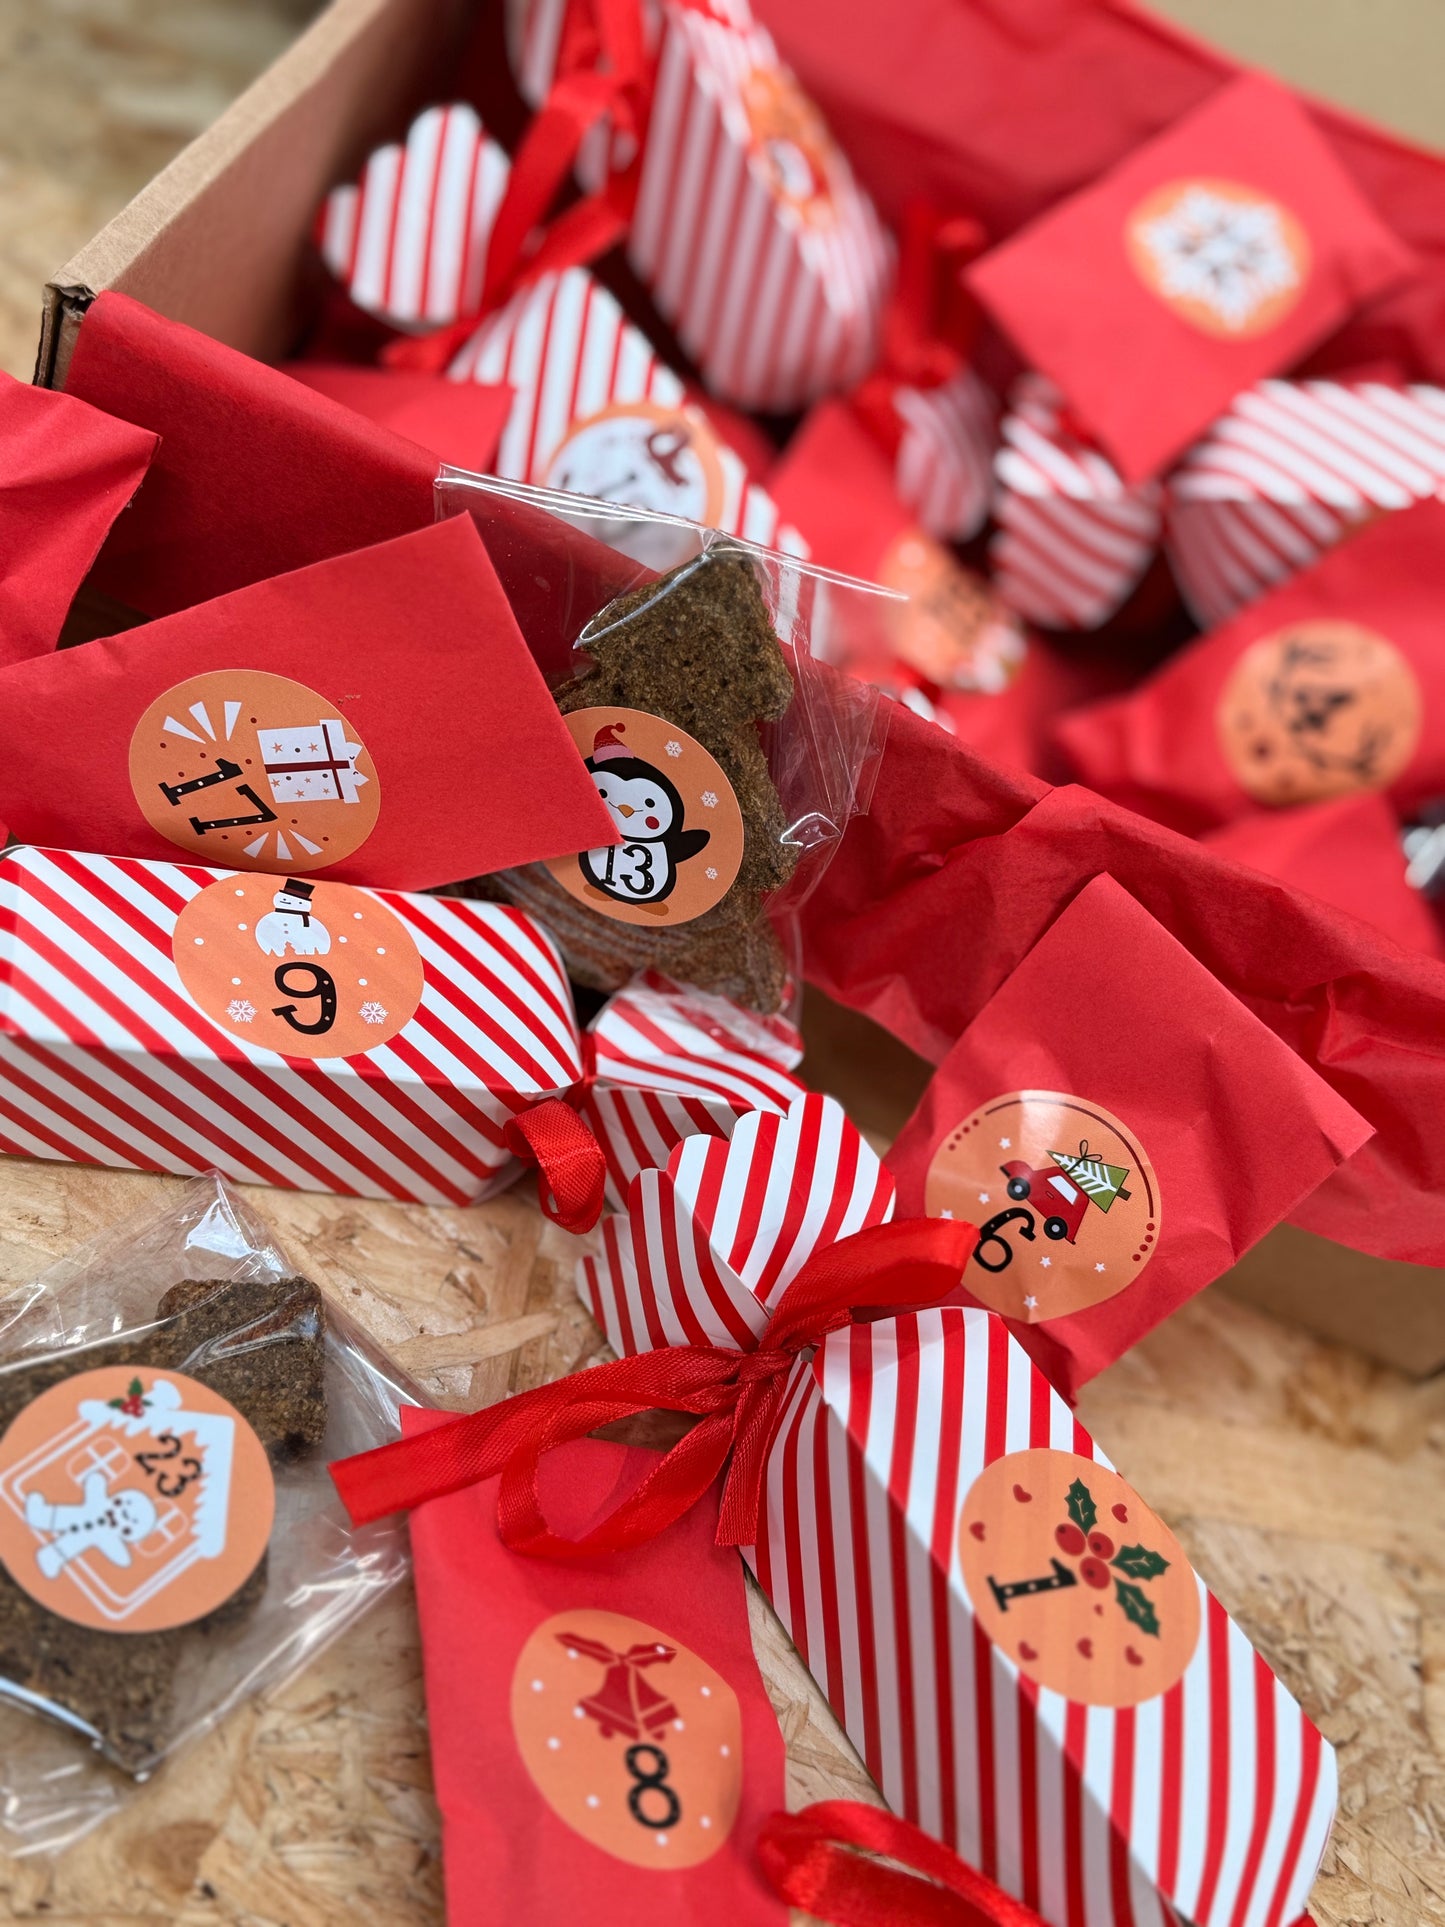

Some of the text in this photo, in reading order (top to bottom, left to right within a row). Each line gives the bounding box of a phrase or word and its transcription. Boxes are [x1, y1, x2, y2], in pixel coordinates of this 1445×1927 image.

[158, 758, 278, 835] 17
[601, 844, 655, 895] 13
[271, 962, 337, 1035] 9
[972, 1207, 1036, 1273] 6
[135, 1434, 202, 1497] 23
[986, 1557, 1078, 1613] 1
[624, 1743, 682, 1831] 8
